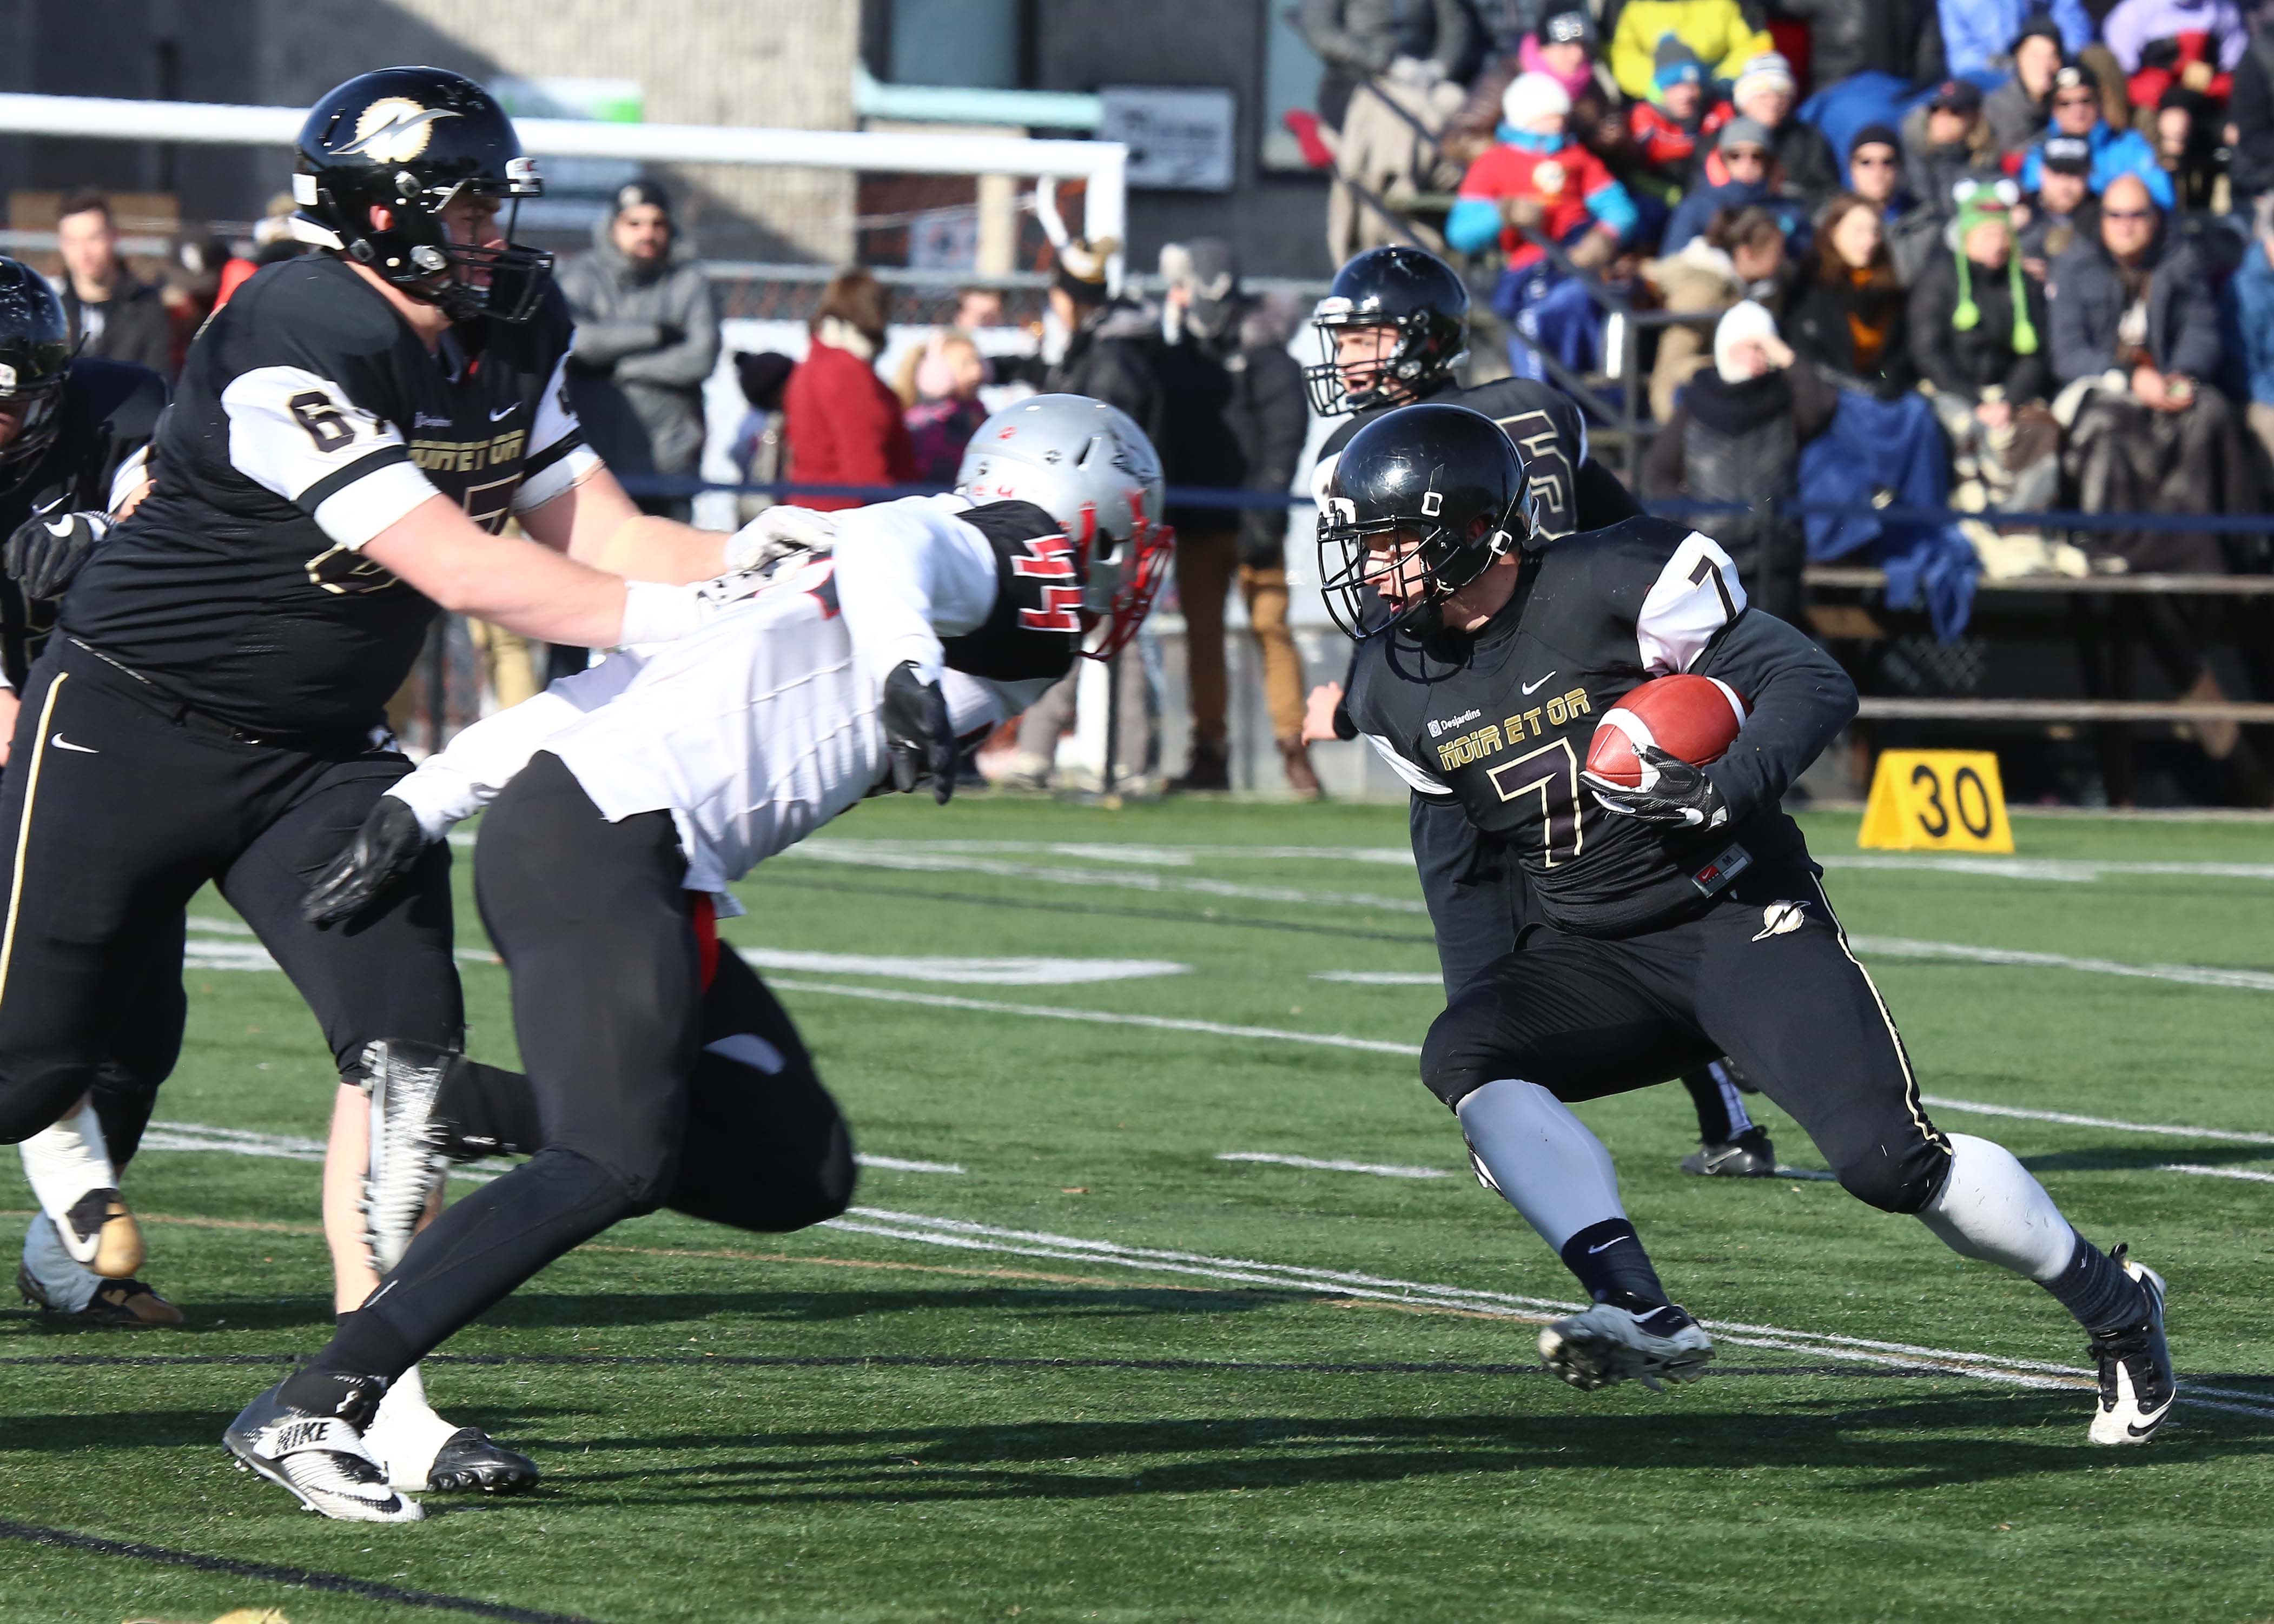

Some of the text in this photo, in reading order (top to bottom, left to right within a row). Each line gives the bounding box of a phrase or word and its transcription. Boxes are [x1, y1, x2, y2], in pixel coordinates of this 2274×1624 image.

[1009, 534, 1086, 632] 44
[1683, 553, 1738, 624] 7
[1437, 688, 1591, 771] NOIR ET OR
[1440, 708, 1481, 731] Desjardins
[1485, 736, 1584, 868] 7
[1913, 765, 1992, 838] 30
[275, 1422, 332, 1456] NIKE
